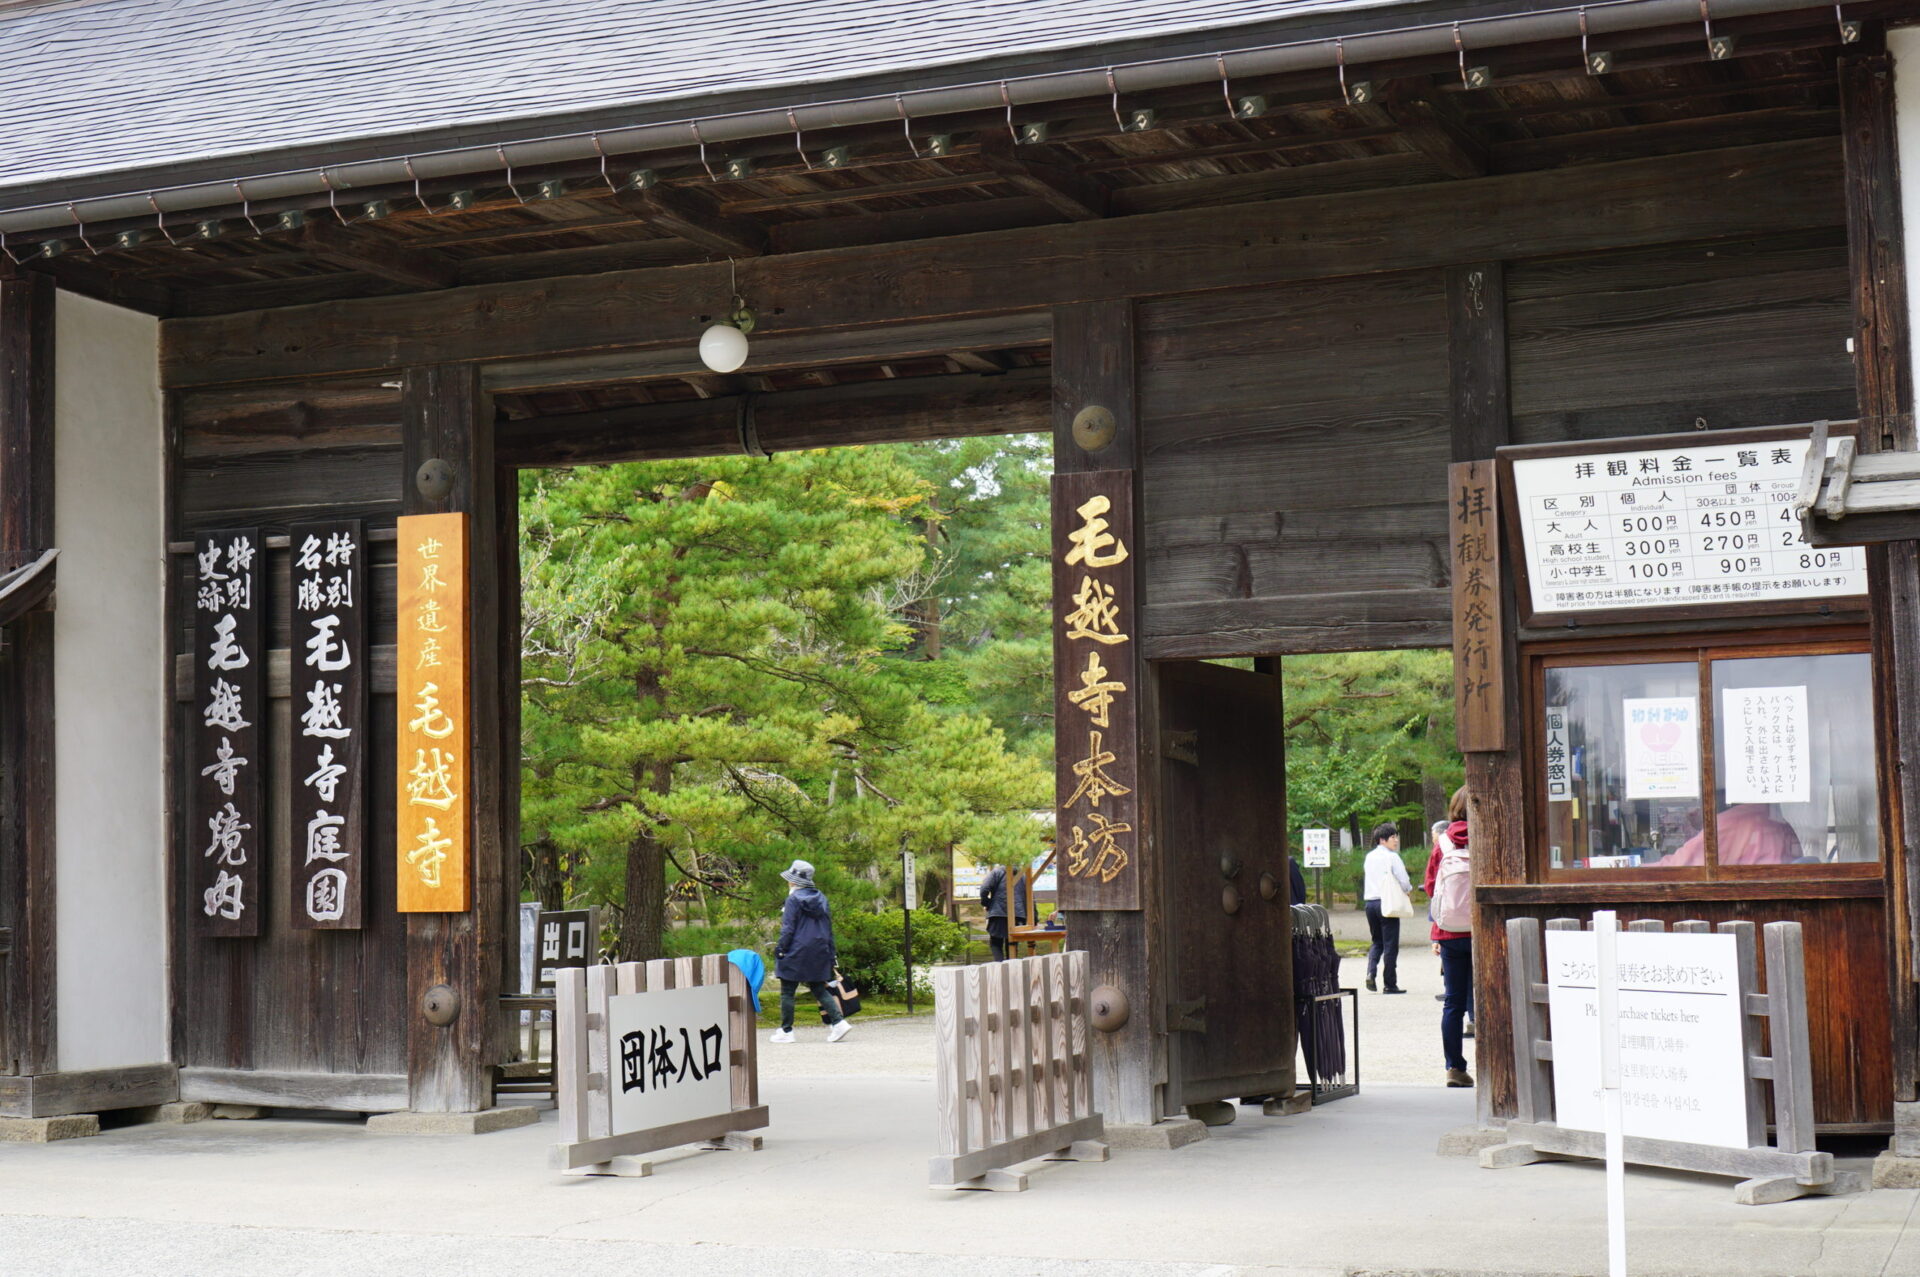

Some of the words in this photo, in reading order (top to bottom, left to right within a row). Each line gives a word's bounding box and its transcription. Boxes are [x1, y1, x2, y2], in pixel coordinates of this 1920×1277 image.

[1575, 448, 1792, 479] 拝観料金一覧表
[1632, 473, 1703, 487] Admission
[1709, 471, 1737, 481] fees
[1544, 495, 1595, 510] 区別
[1620, 490, 1673, 505] 個人
[1547, 518, 1599, 533] 大人
[1550, 541, 1601, 556] 高校生
[542, 921, 585, 960] 出口
[1650, 1007, 1679, 1022] tickets
[1680, 1008, 1700, 1024] here
[620, 1023, 722, 1094] 団体入口
